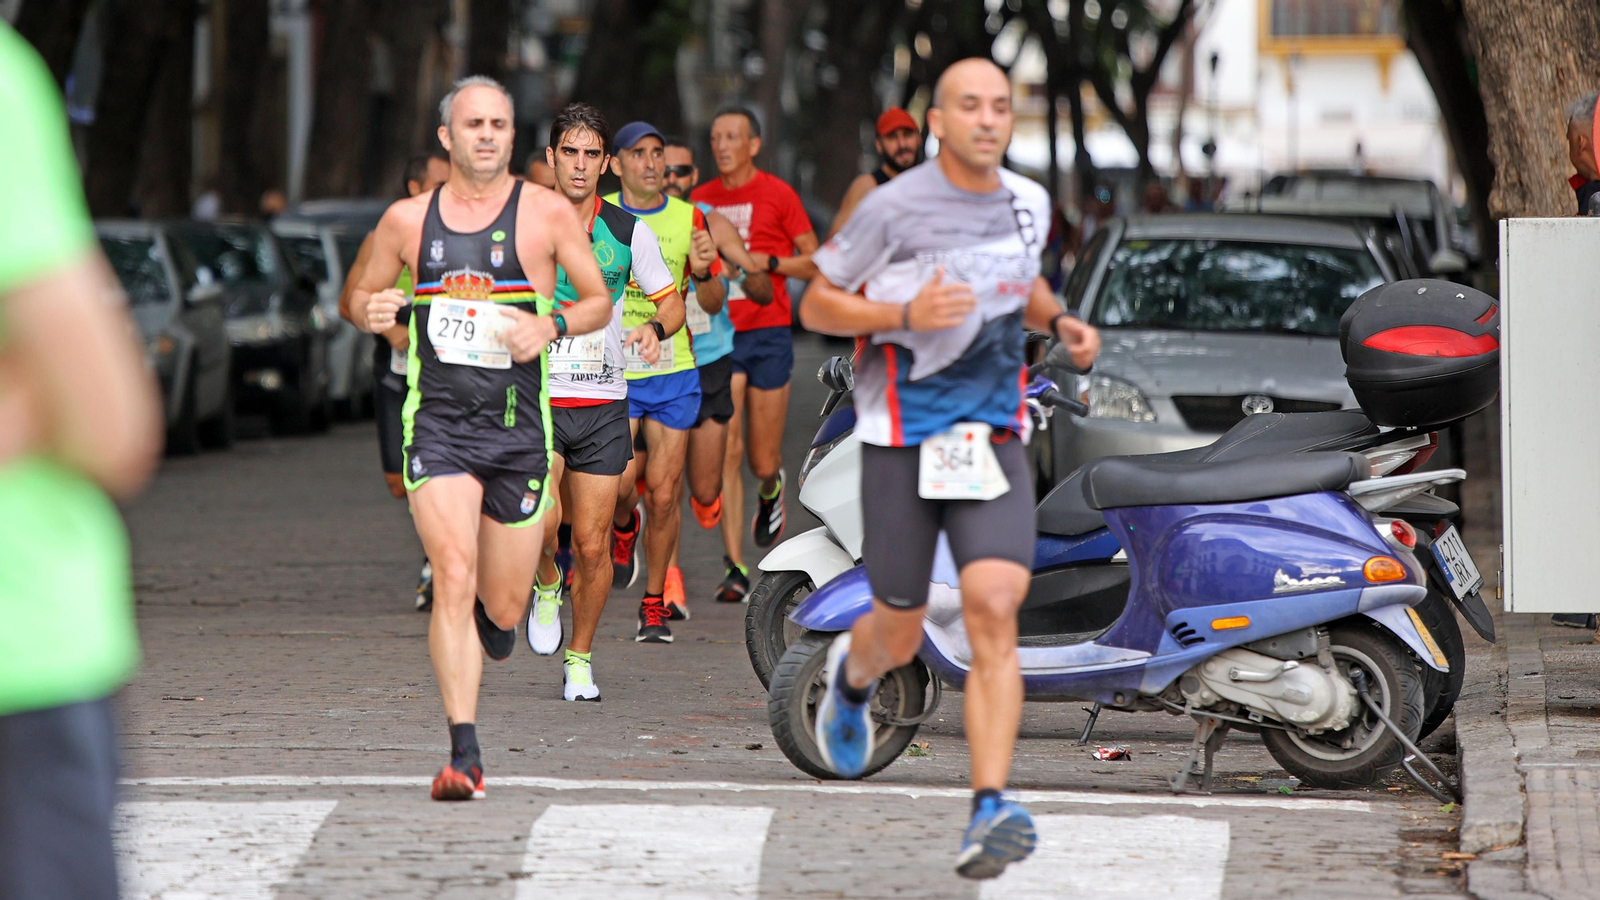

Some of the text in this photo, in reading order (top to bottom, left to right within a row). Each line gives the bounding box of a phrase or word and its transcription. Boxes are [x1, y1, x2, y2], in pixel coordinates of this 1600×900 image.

[437, 317, 475, 342] 279
[933, 447, 973, 471] 364
[1439, 532, 1463, 564] 4211
[1453, 557, 1472, 588] JRX
